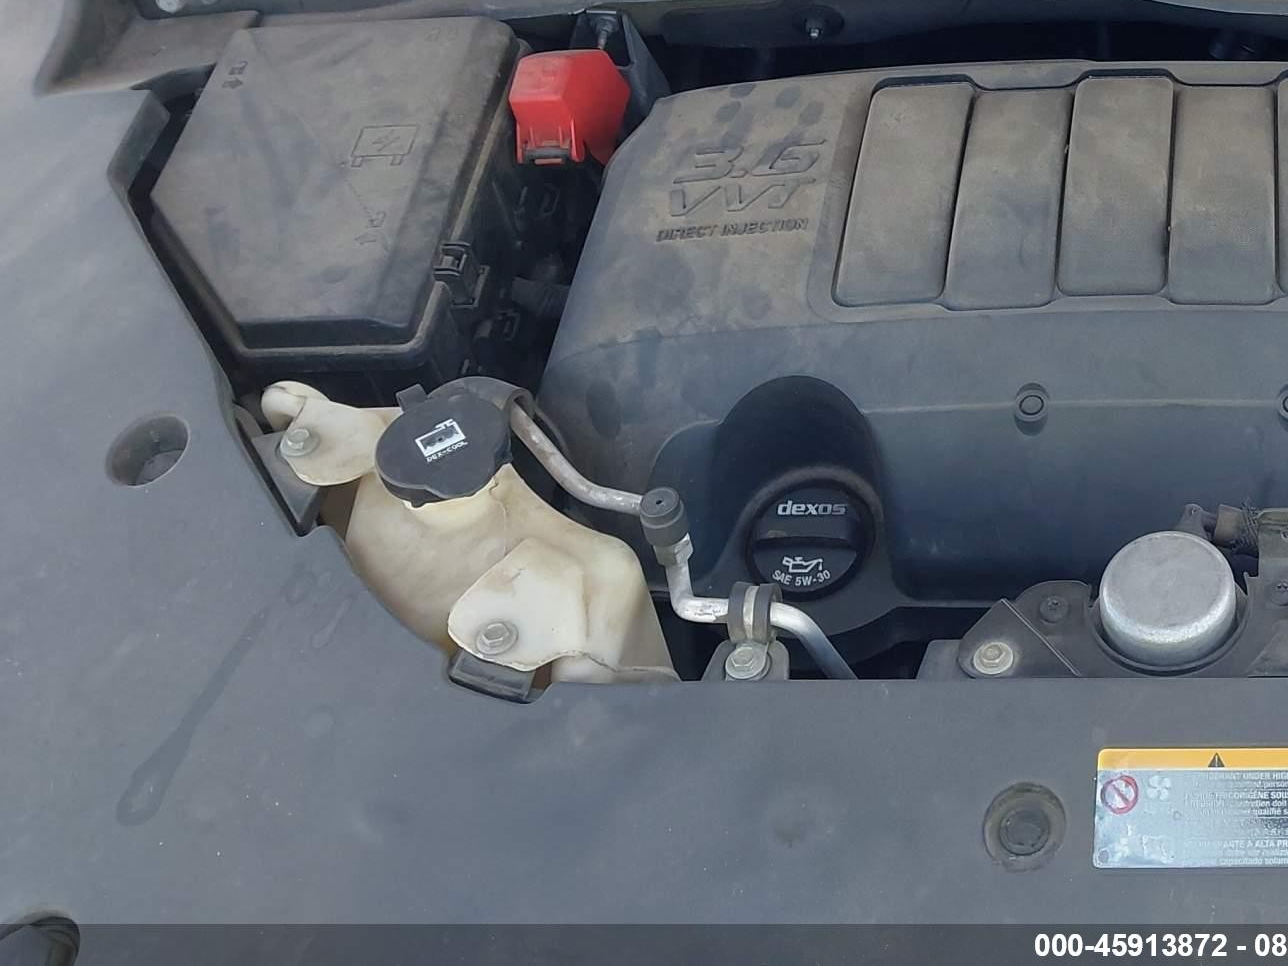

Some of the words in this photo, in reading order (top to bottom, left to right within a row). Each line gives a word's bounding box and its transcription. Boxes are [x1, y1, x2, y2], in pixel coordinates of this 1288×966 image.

[673, 139, 827, 185] 3.6
[656, 224, 718, 243] DIRECT
[720, 217, 810, 237] INJECTION
[426, 441, 469, 463] DEX-COOL
[777, 500, 846, 515] dexos
[771, 569, 793, 586] SAE
[794, 570, 831, 587] 5W-30
[1243, 772, 1271, 780] UNDER
[1272, 799, 1288, 808] doit
[1255, 839, 1275, 849] ALTA
